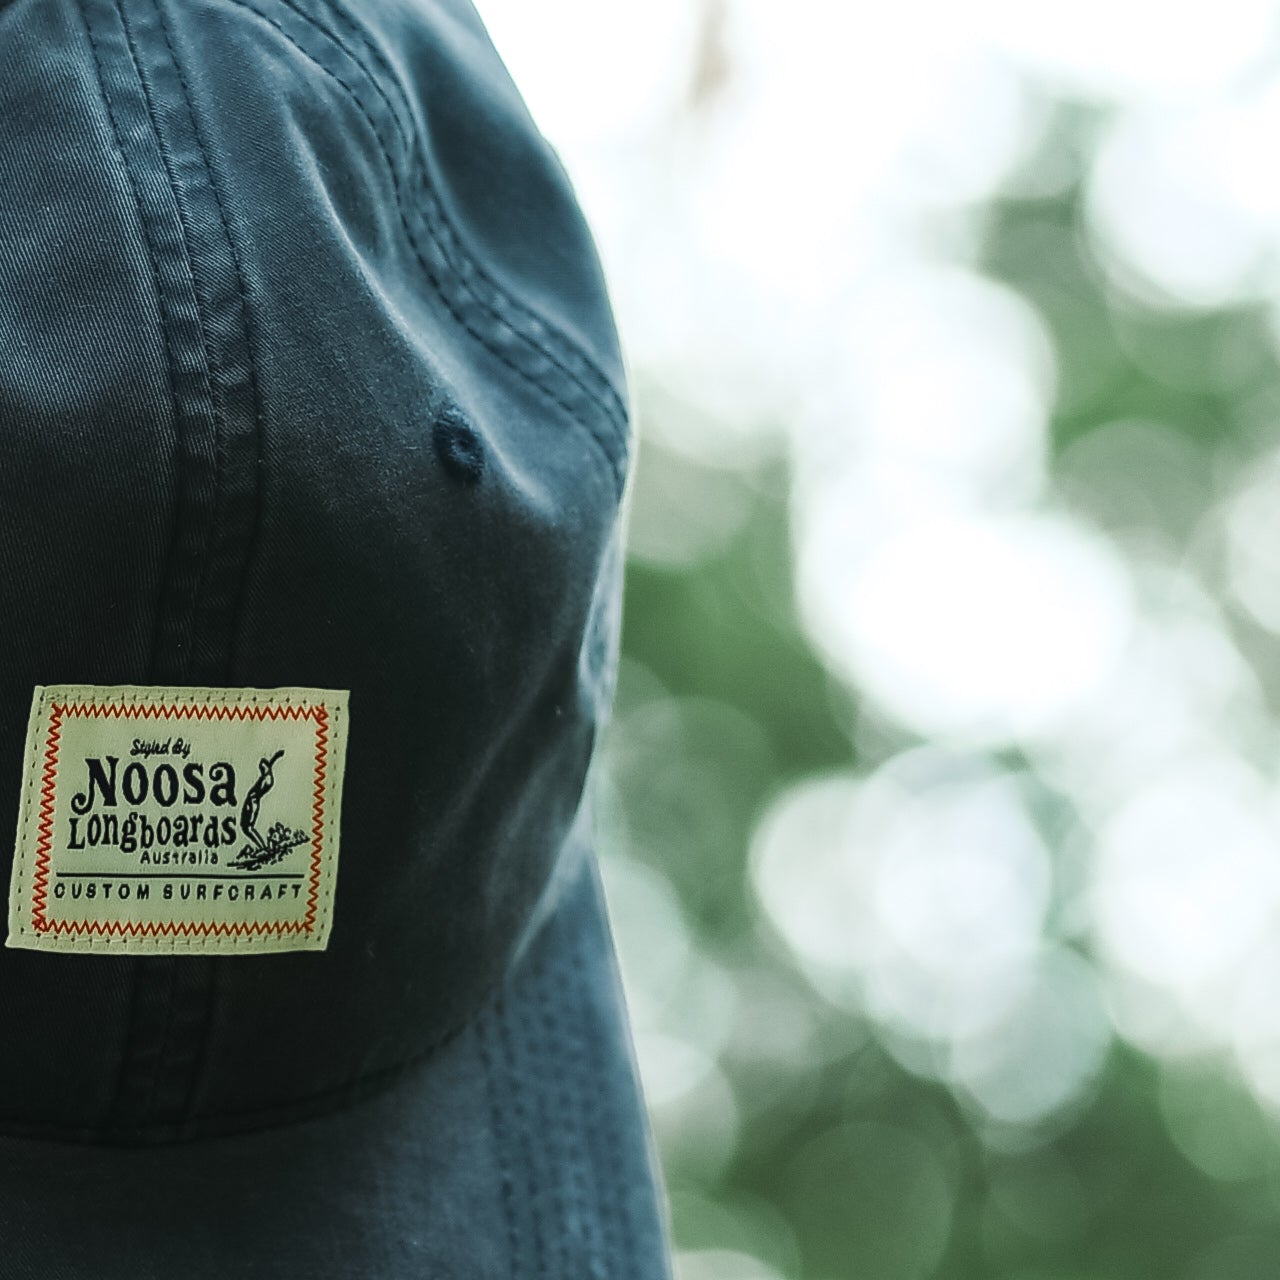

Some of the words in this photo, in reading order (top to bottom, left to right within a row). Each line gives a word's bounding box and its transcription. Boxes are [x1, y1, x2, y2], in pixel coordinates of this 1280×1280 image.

[130, 738, 171, 759] Styled
[172, 737, 192, 758] By
[71, 755, 237, 815] Noosa
[67, 811, 237, 853] Longboards
[140, 851, 219, 865] Australia
[54, 883, 150, 899] CUSTOM
[163, 884, 302, 901] SURFCRAFT
